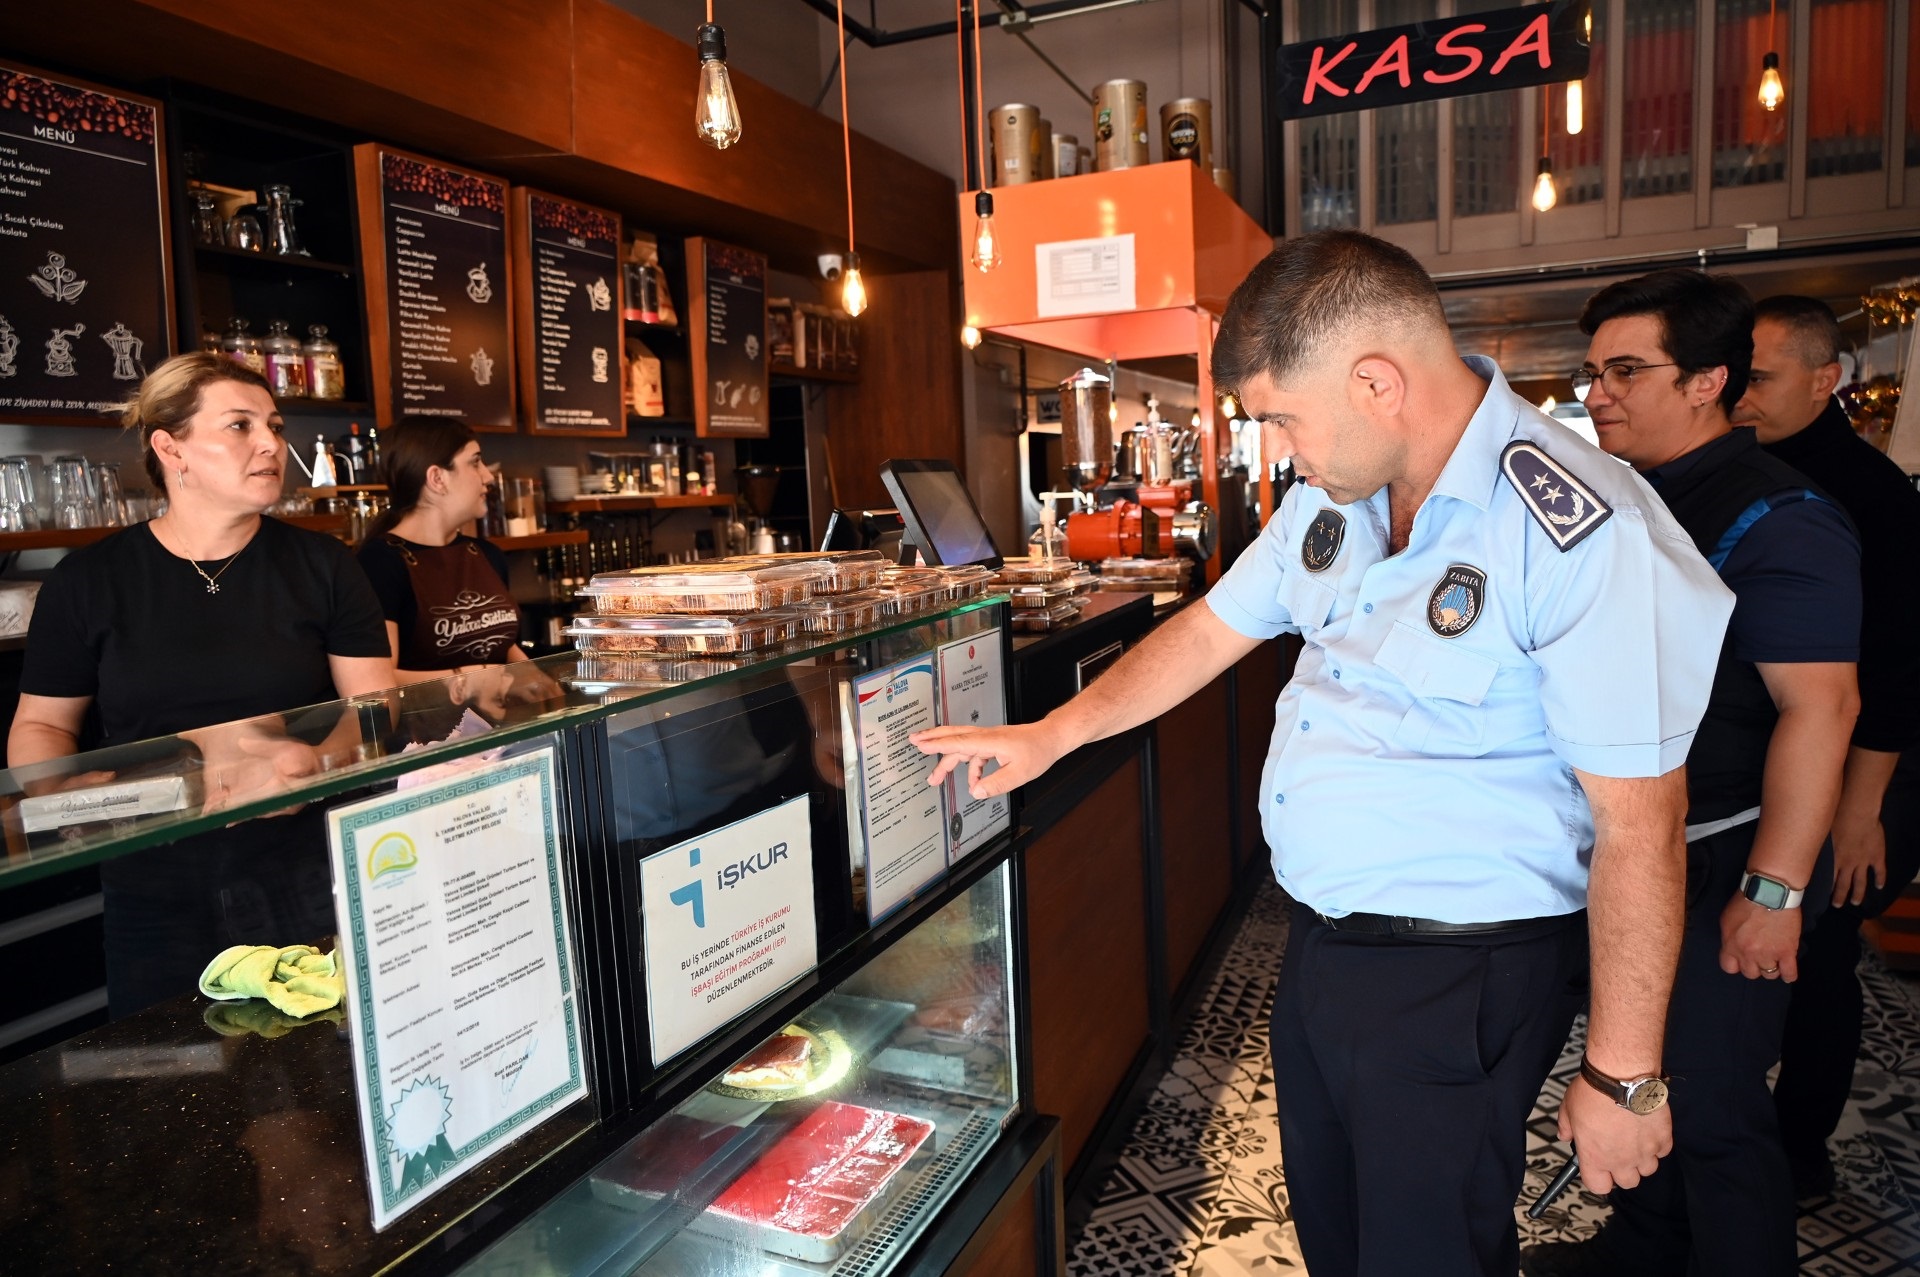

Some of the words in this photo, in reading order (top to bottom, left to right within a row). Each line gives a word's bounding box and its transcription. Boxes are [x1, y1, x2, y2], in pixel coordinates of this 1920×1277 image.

[1302, 13, 1552, 105] KASA
[34, 125, 75, 143] MENÜ
[19, 162, 50, 175] Kahvesi
[9, 174, 41, 187] Kahvesi
[435, 203, 459, 216] MENÜ
[5, 213, 27, 224] Sıcak
[30, 217, 64, 230] Çikolata
[66, 401, 85, 409] ZEVK
[1450, 571, 1479, 586] ZABITA
[893, 678, 909, 690] YALOVA
[453, 813, 472, 822] YALOVA
[441, 826, 455, 834] TARIM
[463, 818, 480, 827] ORMAN
[444, 832, 465, 844] İŞLETME
[466, 826, 480, 835] KAYIT
[481, 819, 501, 830] BELGESİ
[718, 842, 787, 890] İŞKUR
[444, 889, 459, 897] Yalova
[446, 908, 461, 916] Yalova
[681, 958, 691, 970] BU
[692, 954, 699, 964] İŞ
[700, 938, 729, 959] YERİNDE
[731, 923, 757, 942] TÜRKİYE
[758, 919, 764, 929] İŞ
[765, 905, 791, 924] KURUMU
[691, 951, 734, 980] TARAFINDAN
[736, 935, 762, 955] FİNANSE
[764, 922, 785, 939] EDİLEN
[691, 978, 713, 997] İŞBAŞI
[715, 964, 737, 983] EĞİTİM
[772, 936, 786, 950] (İEP)
[707, 958, 774, 1003] DÜZENLENMEKTEDİR.
